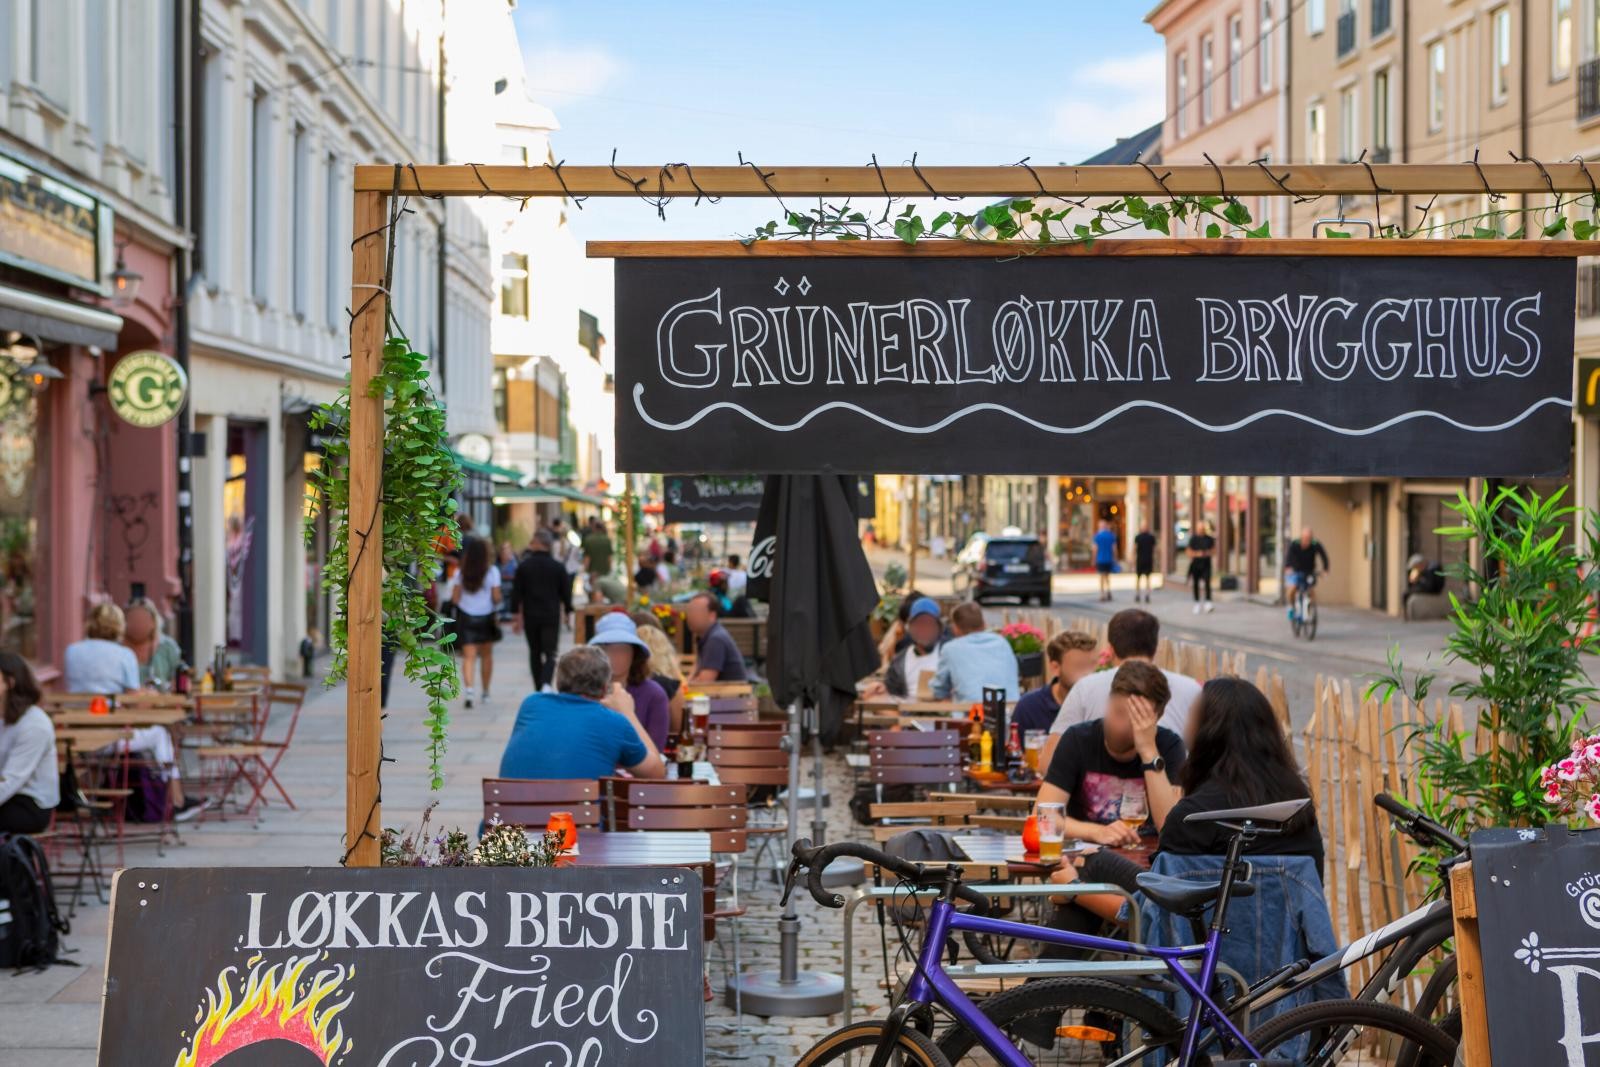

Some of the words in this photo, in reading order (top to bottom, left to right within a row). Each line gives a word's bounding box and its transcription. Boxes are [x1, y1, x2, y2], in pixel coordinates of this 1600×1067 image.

[656, 275, 1171, 388] GRÜNERLØKKA
[1195, 291, 1542, 381] BRYGGHUS
[242, 890, 489, 949] LØKKAS
[504, 890, 688, 950] BESTE
[425, 951, 659, 1044] Fried
